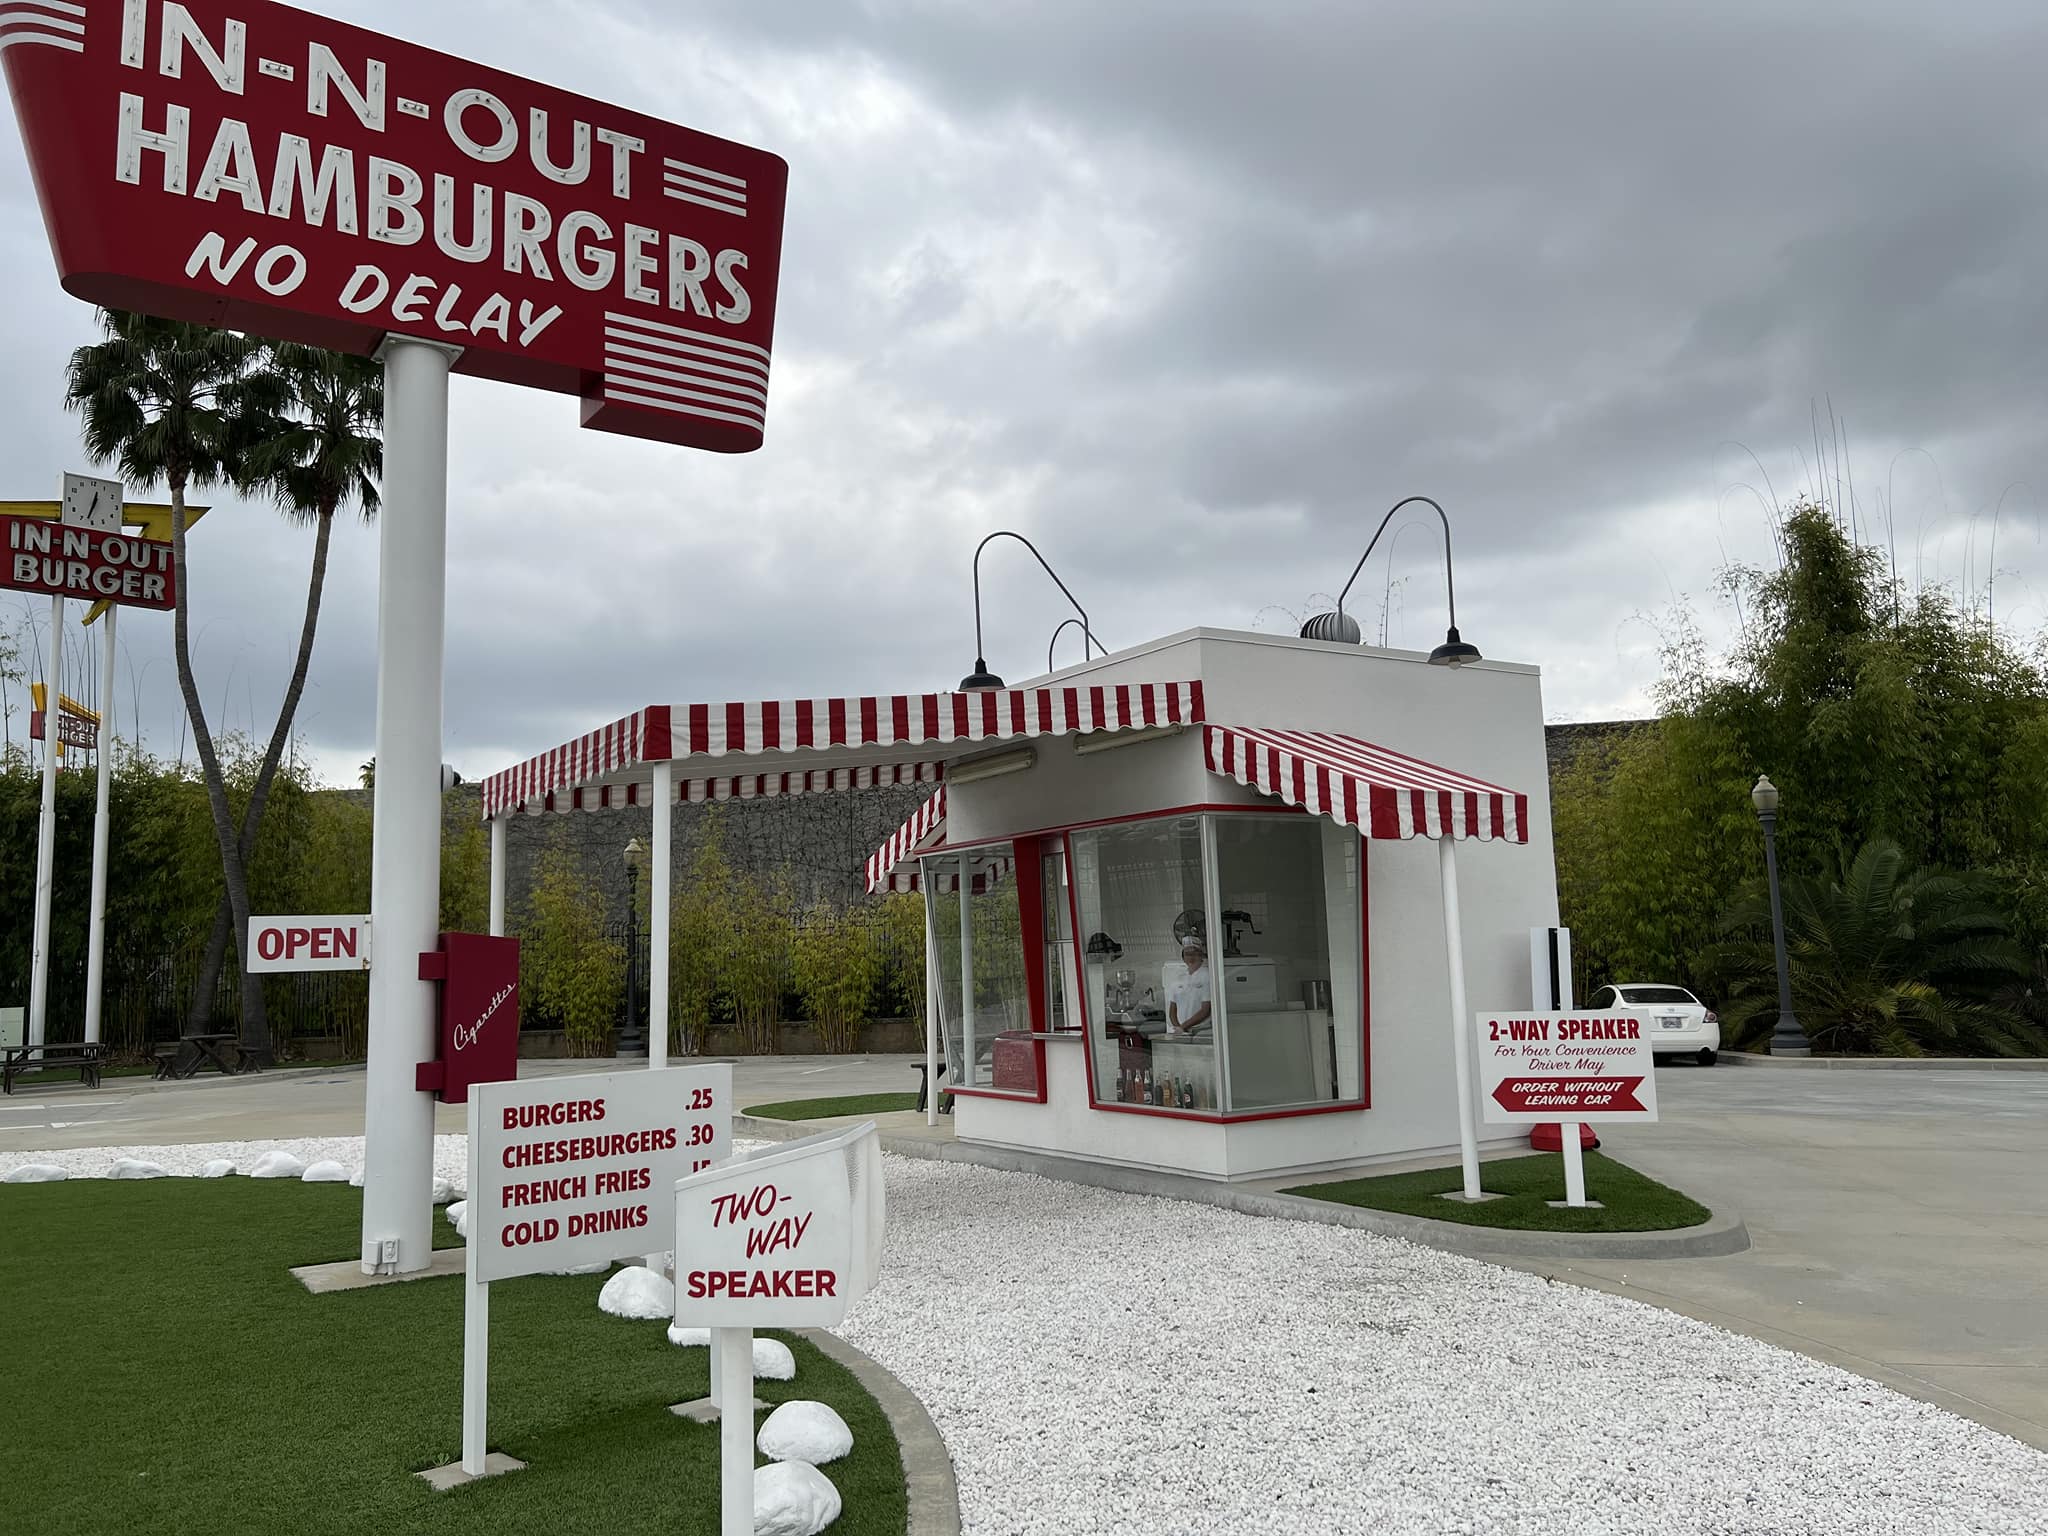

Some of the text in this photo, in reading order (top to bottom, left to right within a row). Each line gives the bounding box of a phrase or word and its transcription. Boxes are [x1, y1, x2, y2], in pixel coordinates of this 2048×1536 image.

[119, 0, 645, 200] IN-N-OUT
[116, 92, 750, 325] HAMBURGERS
[185, 231, 563, 347] NO DELAY
[10, 520, 174, 572] IN-N-OUT
[13, 552, 166, 601] BURGER
[257, 927, 357, 961] OPEN
[453, 983, 517, 1051] Cigarettes
[1488, 1020, 1550, 1041] 2-WAY
[1558, 1018, 1640, 1040] SPEAKER
[1494, 1043, 1637, 1057] For Your Convenience
[1528, 1058, 1606, 1076] Driver May
[502, 1088, 713, 1130] BURGERS .25
[1511, 1081, 1624, 1093] ORDER WITHOUT
[1524, 1094, 1612, 1106] LEAVING CAR
[502, 1123, 714, 1169] CHEESEBURGERS .30
[502, 1175, 586, 1208] FRENCH
[595, 1167, 651, 1194] FRIES
[710, 1183, 793, 1228] TWO-
[501, 1204, 648, 1248] COLD DRINKS
[746, 1211, 813, 1259] WAY
[687, 1269, 836, 1298] SPEAKER
